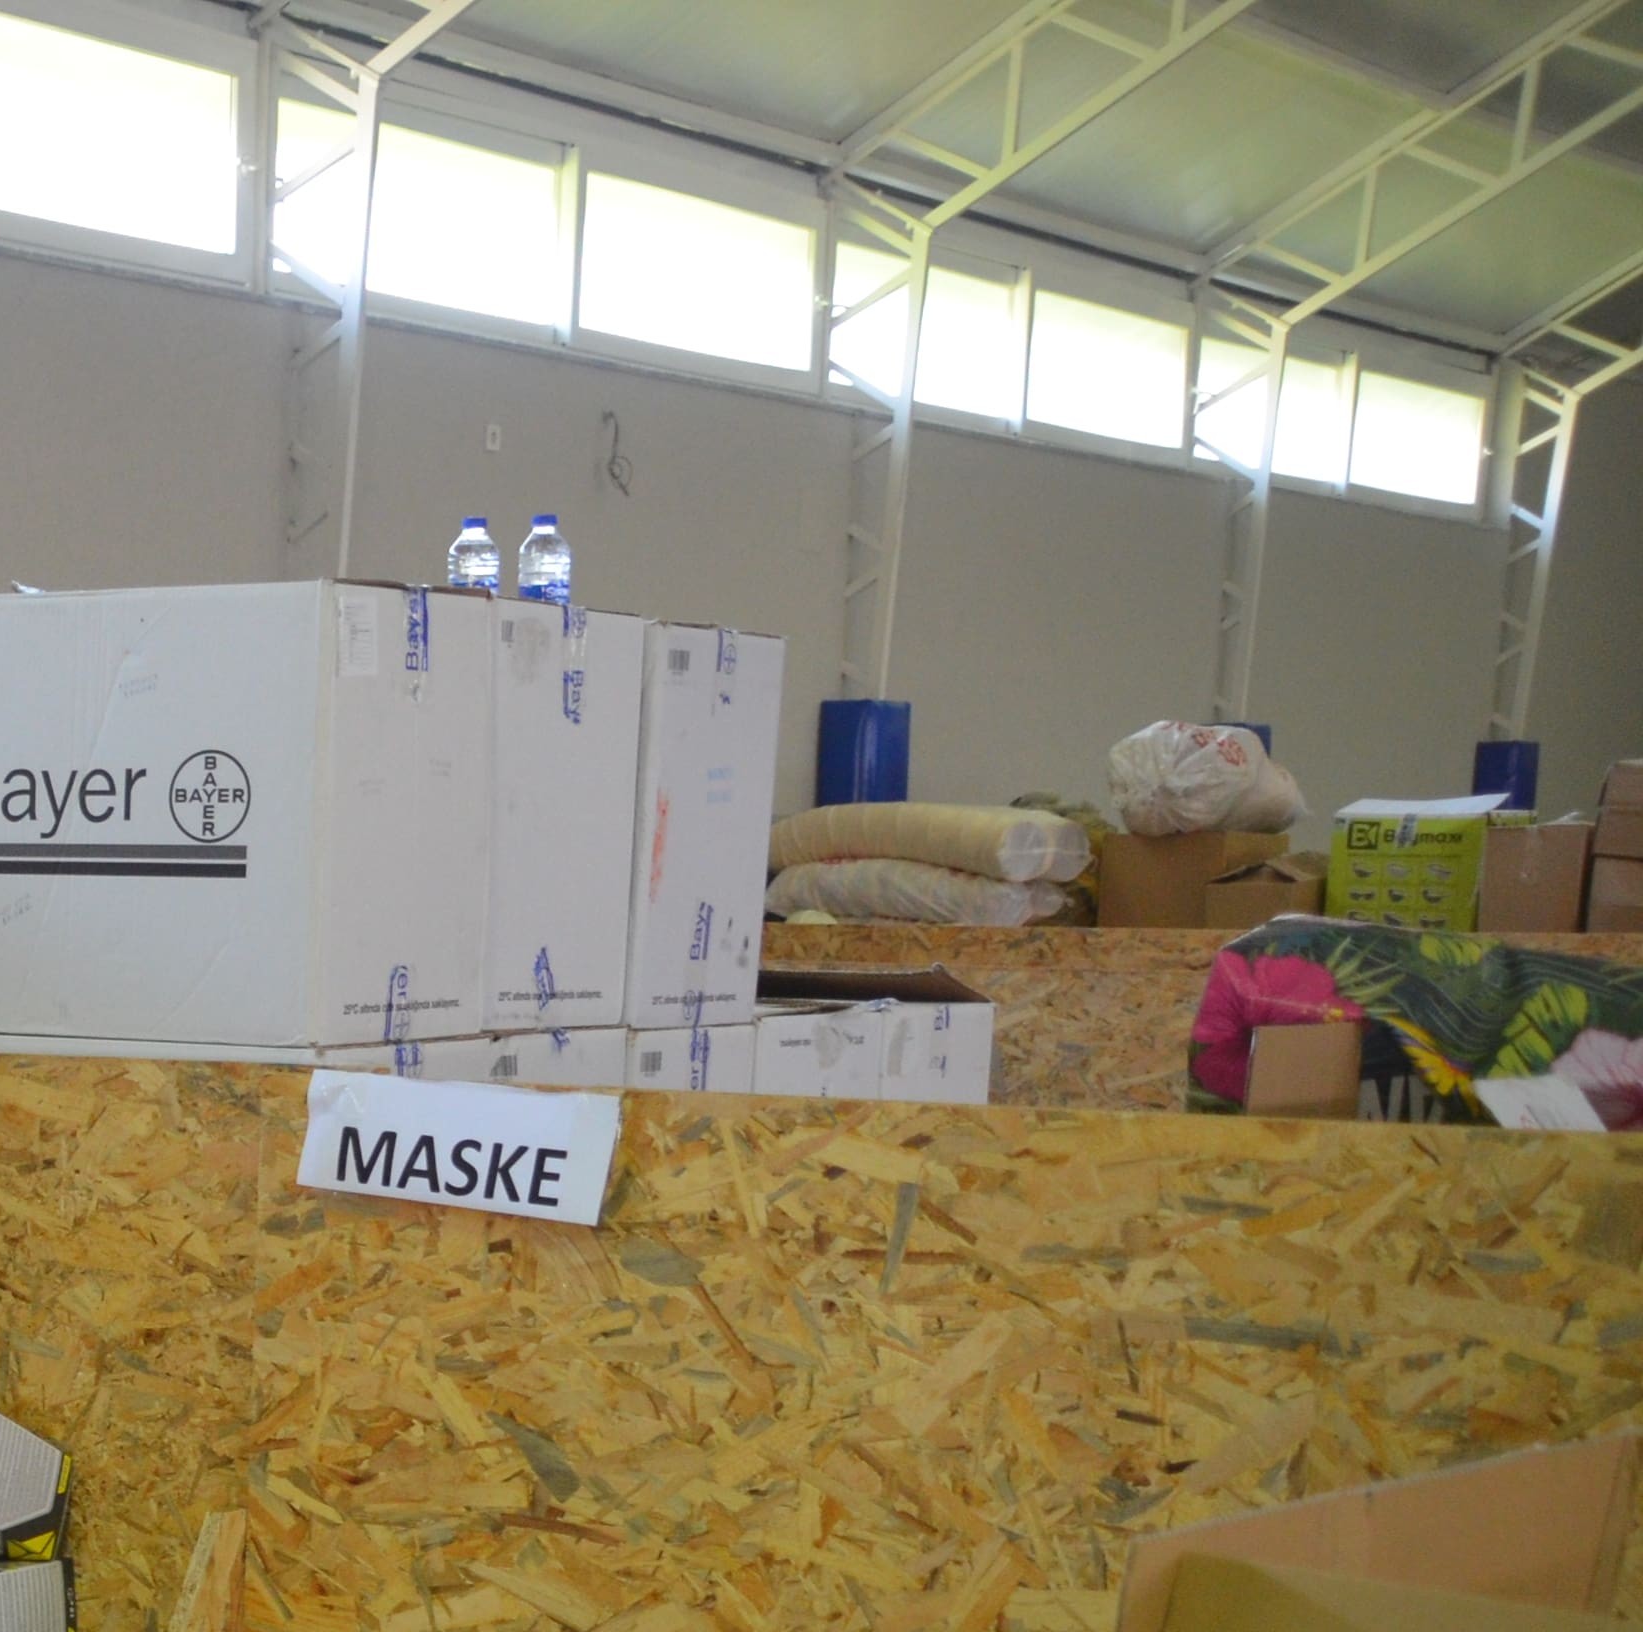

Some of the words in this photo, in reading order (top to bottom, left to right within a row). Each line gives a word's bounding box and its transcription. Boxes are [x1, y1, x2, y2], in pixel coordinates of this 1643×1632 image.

[173, 787, 246, 805] BAYER
[201, 755, 217, 838] BAYER
[334, 1124, 569, 1210] MASKE
